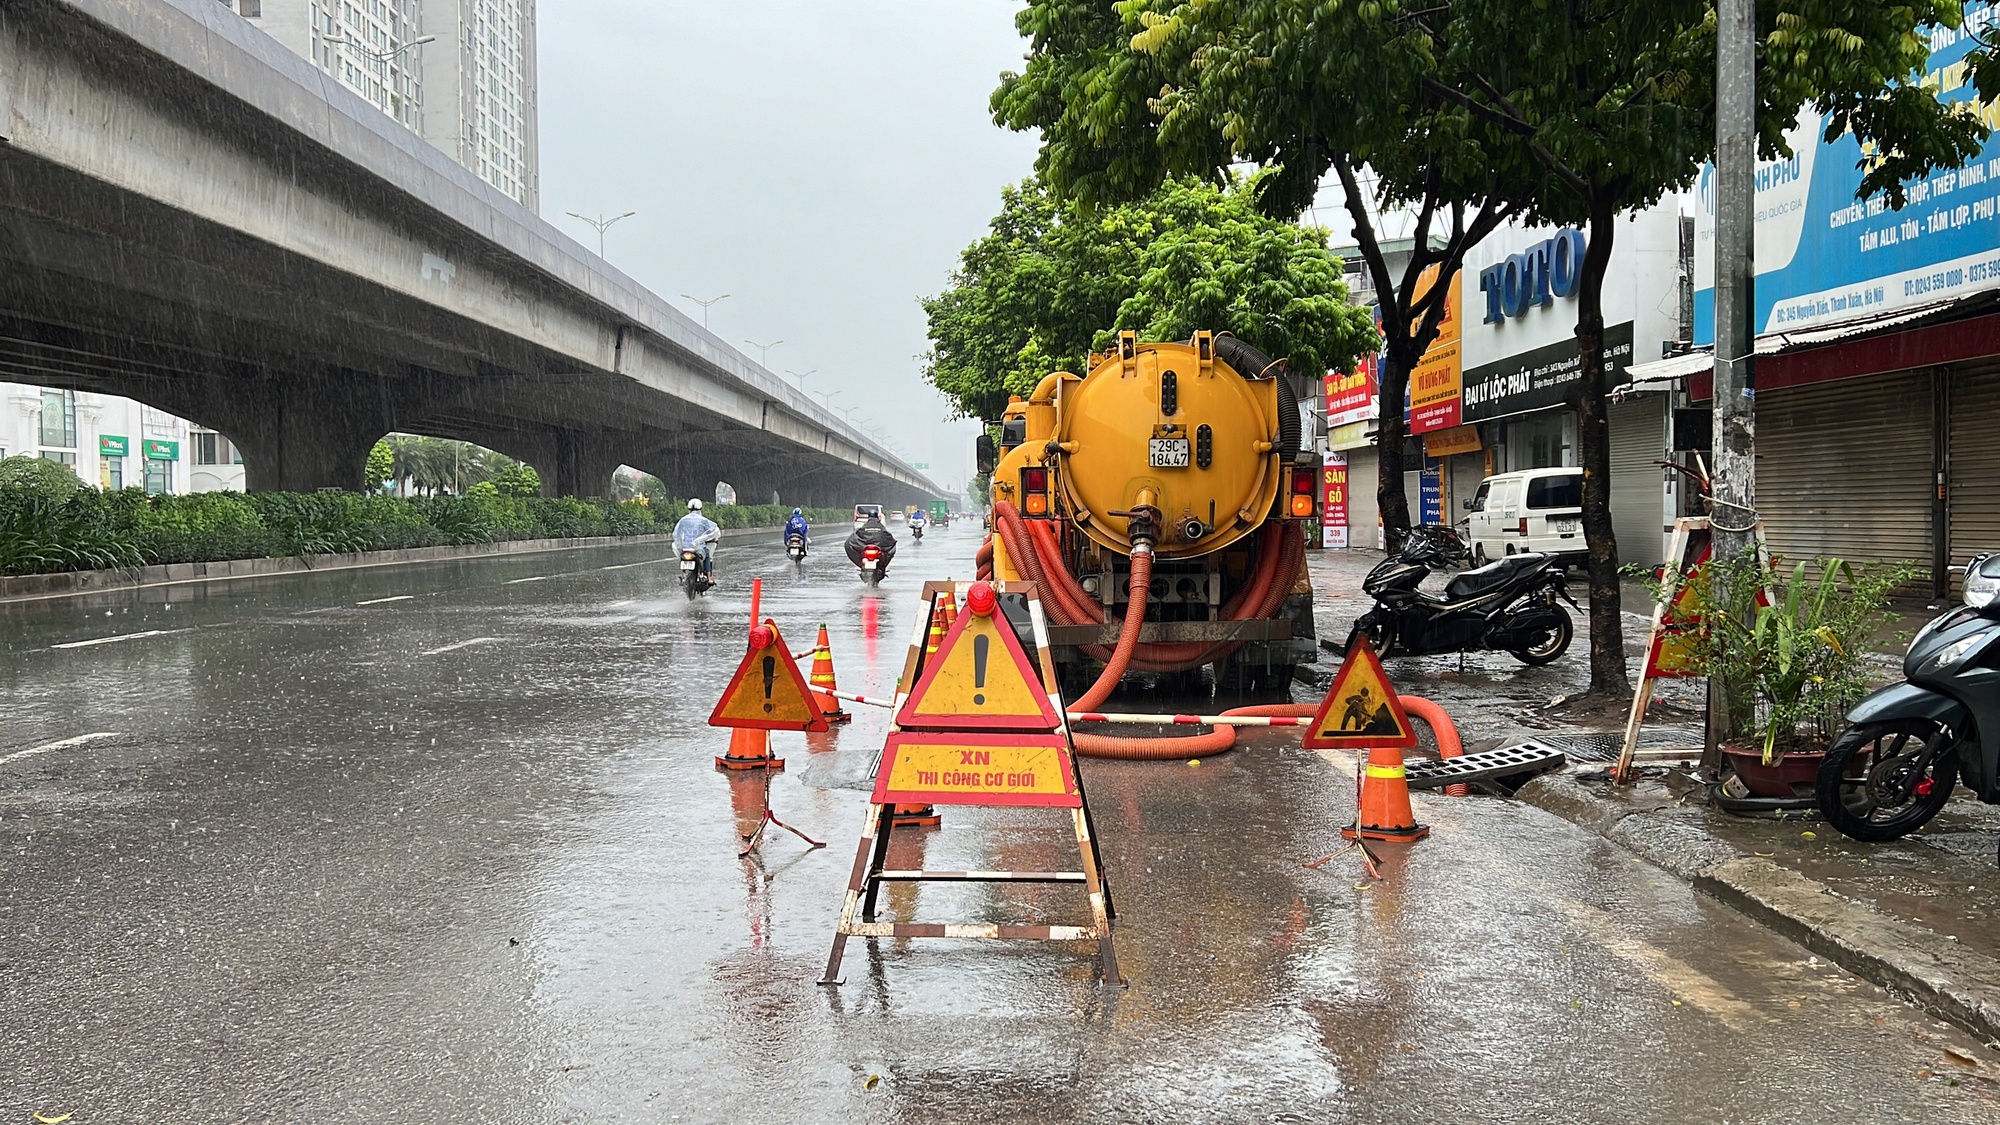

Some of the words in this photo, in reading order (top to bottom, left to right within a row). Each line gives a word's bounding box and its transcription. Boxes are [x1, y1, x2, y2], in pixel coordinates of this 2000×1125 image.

[1830, 202, 1865, 229] CHUYÊN:
[1909, 181, 1930, 206] HỘP,
[1932, 172, 1957, 198] THÉP
[1958, 163, 1987, 189] HÌNH,
[1790, 198, 1803, 213] GIA
[1859, 227, 1879, 252] TẤM
[1880, 225, 1899, 249] ALU,
[1901, 217, 1920, 241] TÔN
[1927, 207, 1949, 234] TẤM
[1951, 204, 1971, 231] LỢP,
[1973, 196, 1995, 221] PHỤ
[1480, 228, 1586, 325] TOTO
[1915, 275, 1931, 295] 0243
[1932, 272, 1944, 291] 559
[1946, 267, 1962, 288] 0080
[1969, 262, 1987, 283] 0375
[1465, 387, 1479, 410] ĐẠI
[1480, 376, 1489, 405] LÝ
[1490, 373, 1506, 405] LỘC
[1508, 365, 1531, 397] PHÁT
[1158, 440, 1179, 452] 29C
[1151, 453, 1187, 466] 184.47
[1325, 469, 1346, 484] SÀN
[1328, 486, 1343, 503] GỖ
[1330, 529, 1340, 537] 339
[960, 750, 990, 766] XN
[918, 770, 938, 786] THI
[942, 768, 981, 787] CÔNG
[984, 772, 1005, 788] CƠ
[1007, 767, 1036, 788] GIỚI
